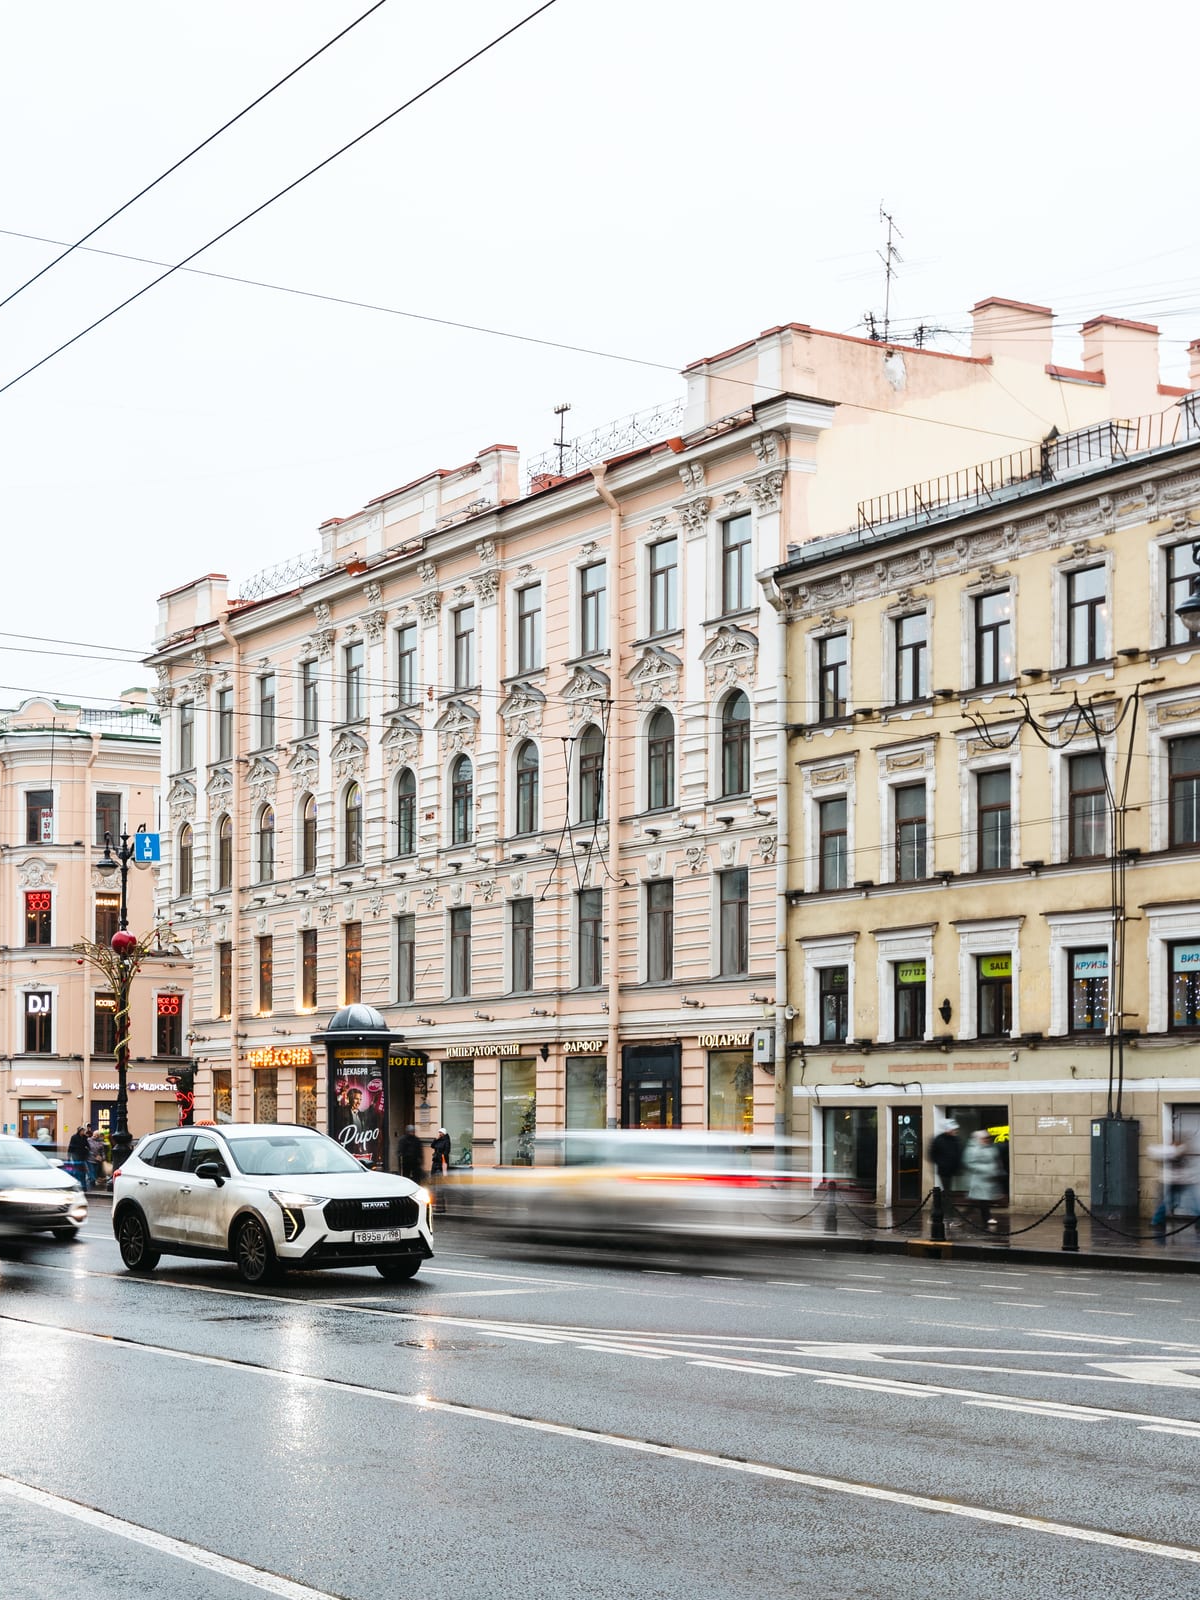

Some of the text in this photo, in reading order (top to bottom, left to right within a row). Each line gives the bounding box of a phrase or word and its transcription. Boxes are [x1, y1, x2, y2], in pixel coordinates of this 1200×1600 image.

[29, 900, 50, 911] 300
[990, 961, 1009, 971] SALE
[28, 994, 50, 1013] DJ
[158, 1004, 178, 1015] 300
[697, 1033, 750, 1049] ПОДАРКИ
[446, 1040, 603, 1057] ИМПЕРАТОРСКИЙ ФАРФОР
[388, 1057, 424, 1066] HOTEL
[343, 1067, 368, 1076] ДЕКАБРЯ
[338, 1124, 379, 1151] Pupo
